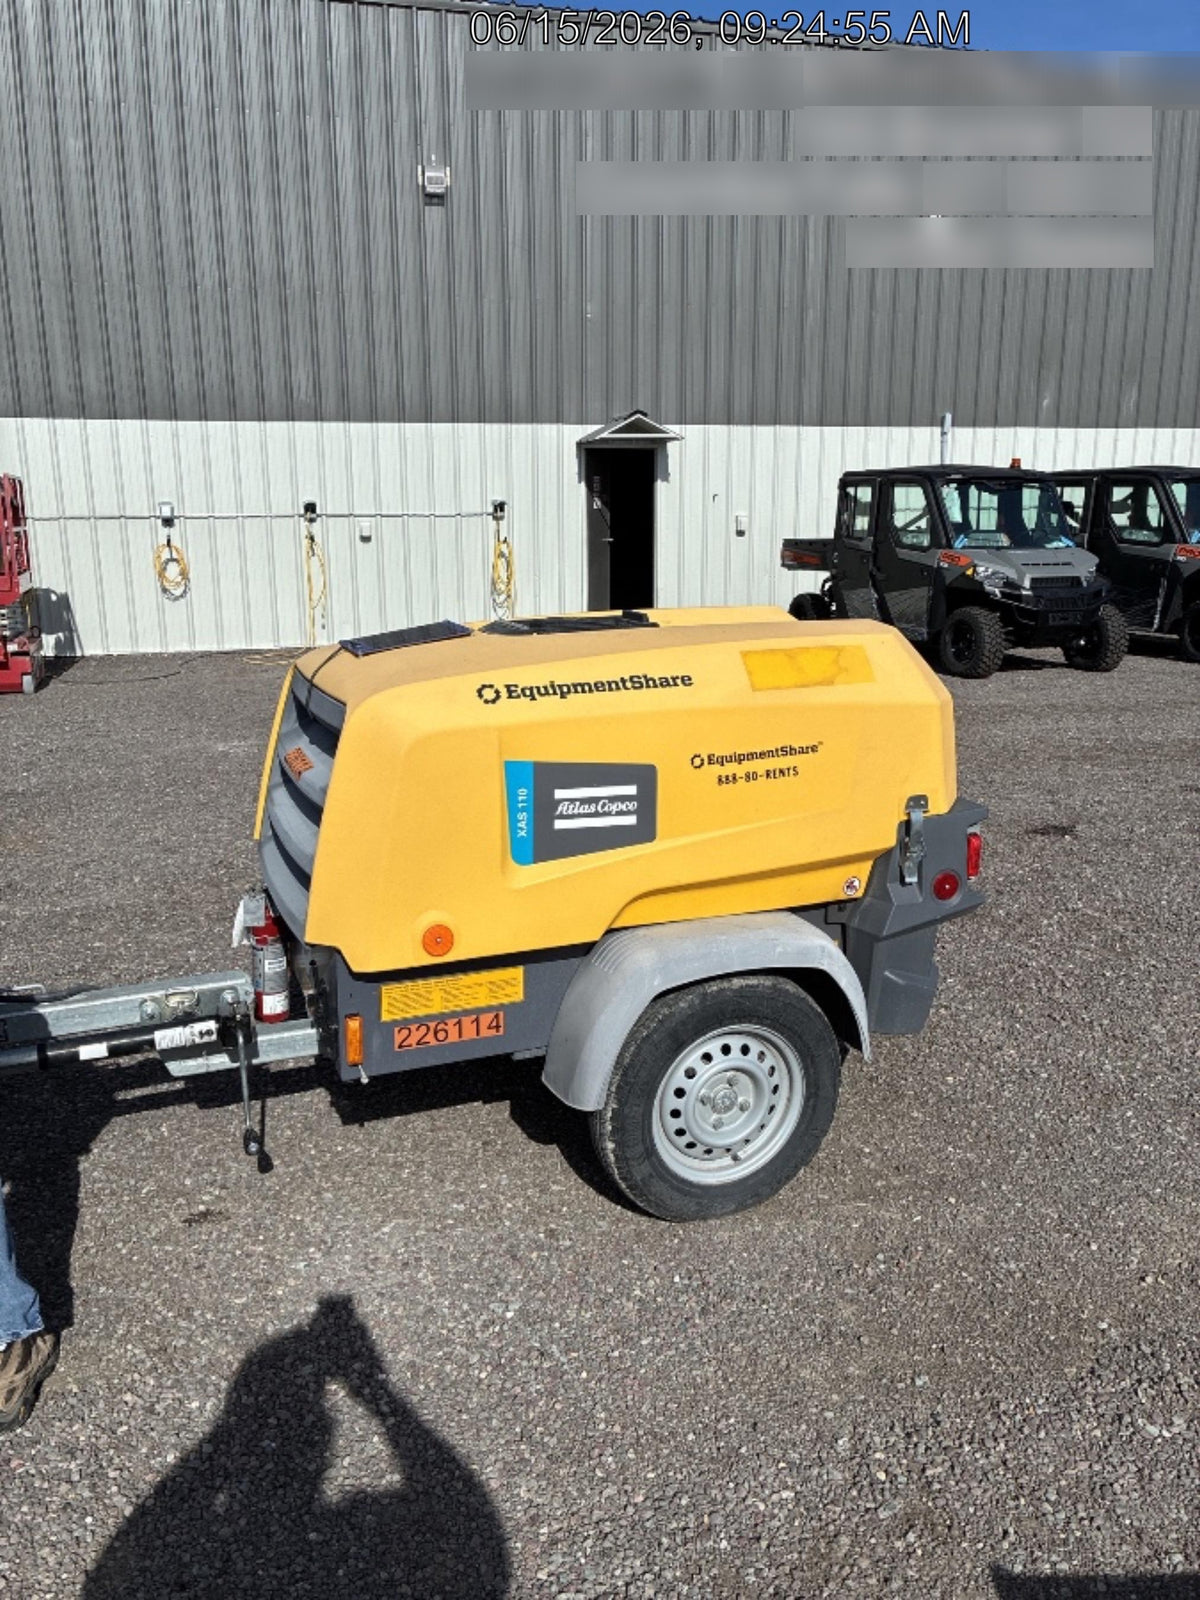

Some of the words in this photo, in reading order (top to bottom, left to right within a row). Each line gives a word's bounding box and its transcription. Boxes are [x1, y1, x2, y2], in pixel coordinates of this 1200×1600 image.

[504, 674, 694, 701] EquipmentShare
[717, 765, 799, 786] 888-80-RENTS
[516, 788, 528, 809] 110
[554, 800, 596, 816] Atlas
[597, 798, 638, 815] Copco
[516, 811, 528, 838] XAS
[397, 1012, 502, 1050] 226114
